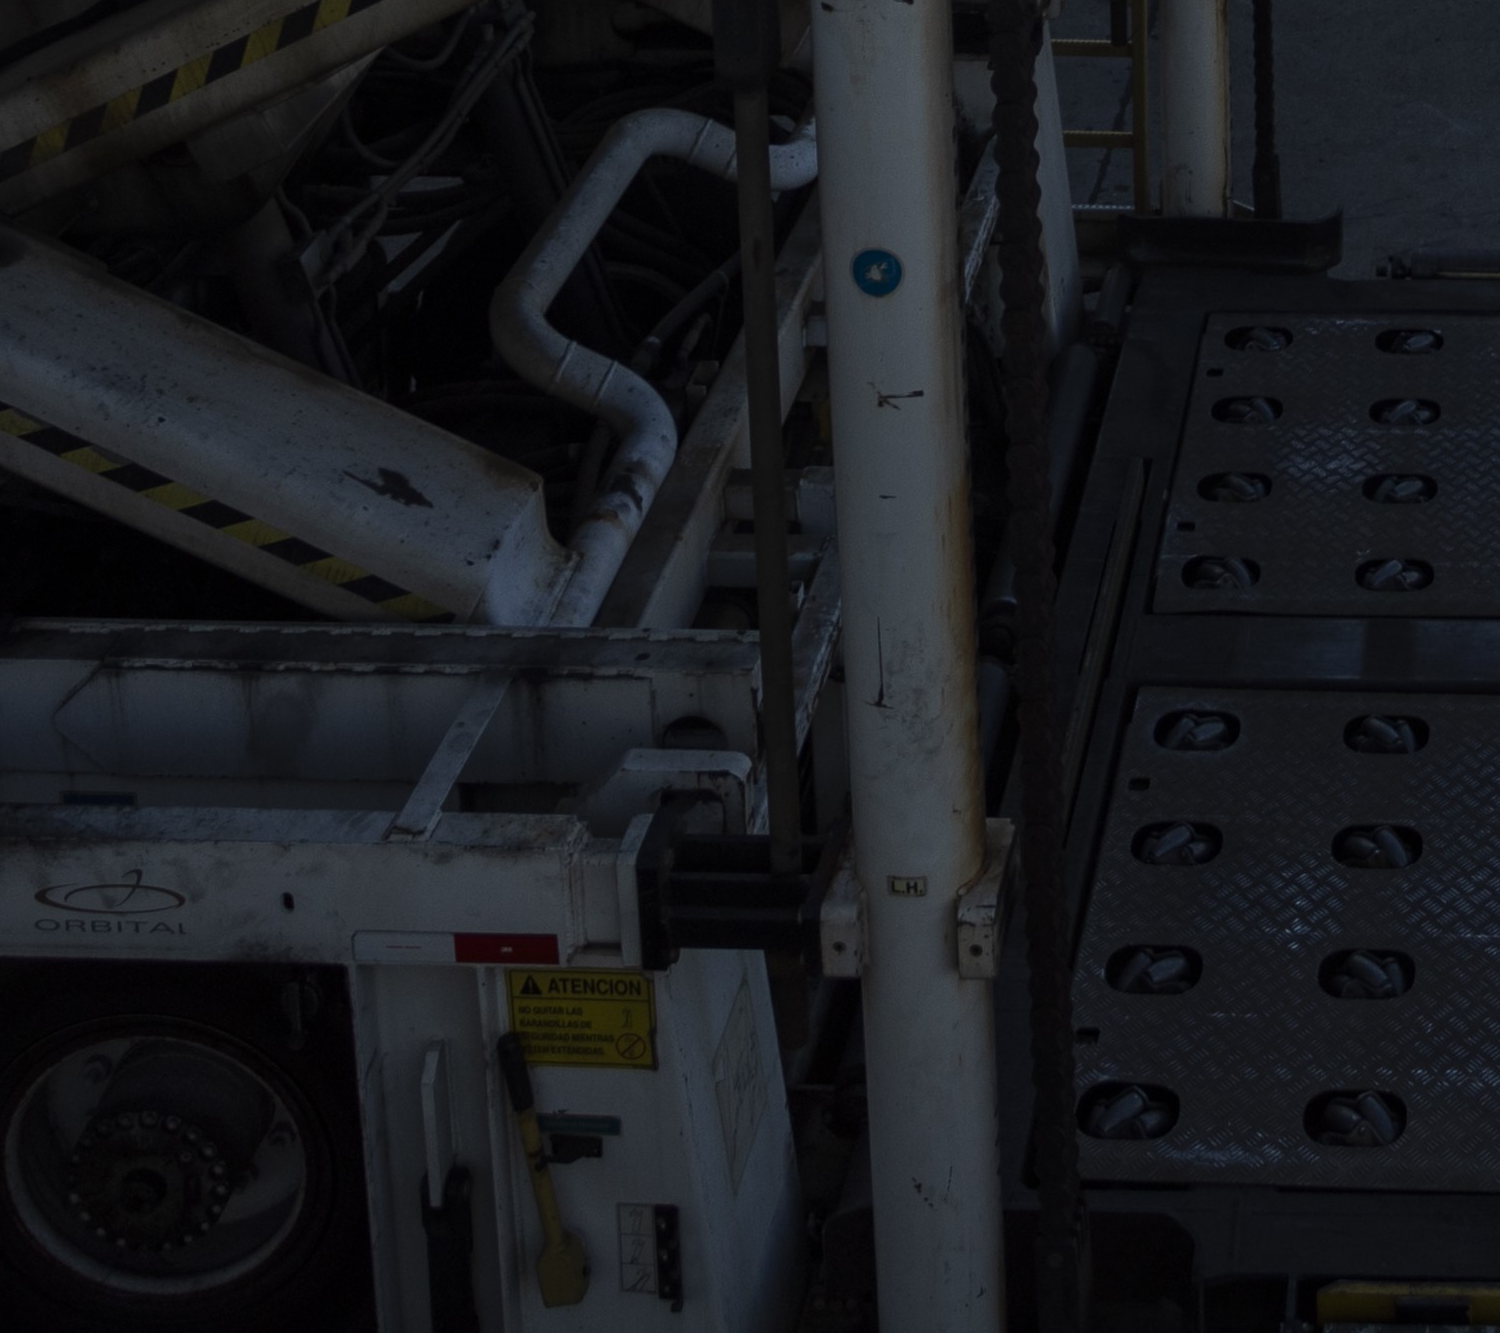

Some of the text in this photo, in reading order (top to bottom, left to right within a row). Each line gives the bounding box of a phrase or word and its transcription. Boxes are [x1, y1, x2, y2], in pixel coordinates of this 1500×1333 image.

[891, 880, 923, 894] L.H.
[34, 918, 188, 935] ORBITAL
[548, 978, 641, 996] ATENCION
[518, 1005, 583, 1016] NO QUITAR LAS
